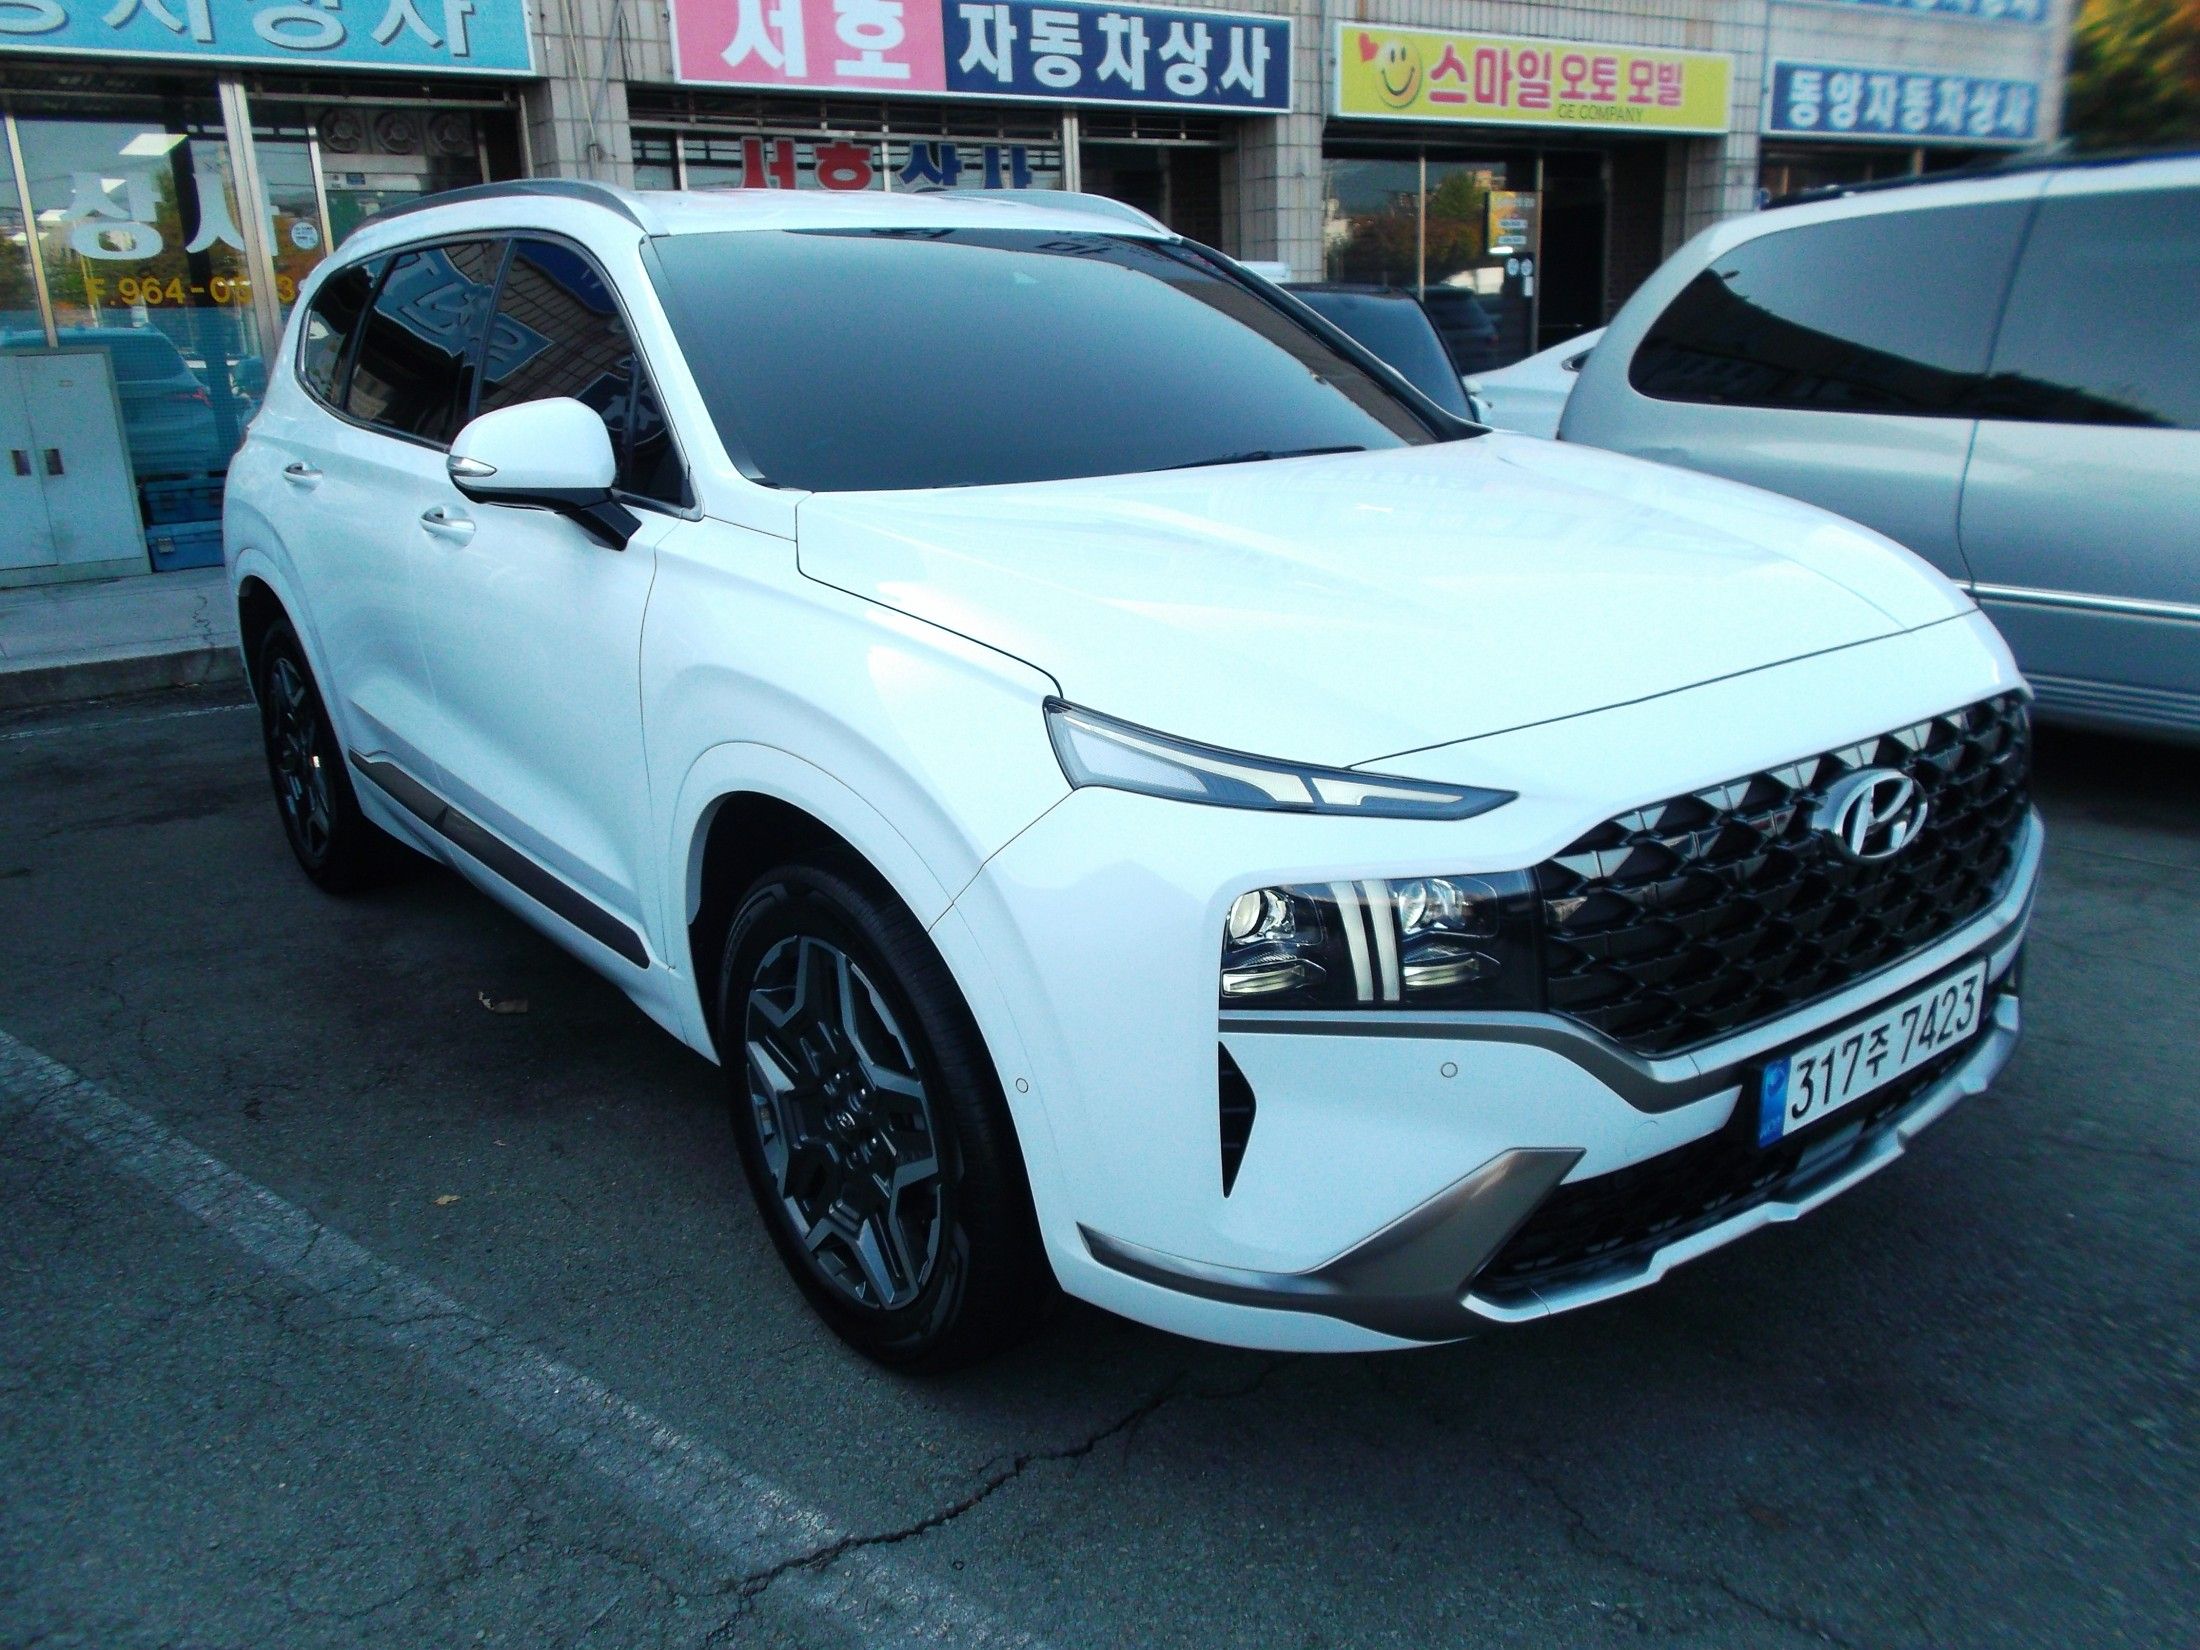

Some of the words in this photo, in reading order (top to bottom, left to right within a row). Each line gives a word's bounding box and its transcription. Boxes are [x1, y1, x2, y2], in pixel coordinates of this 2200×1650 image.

[721, 0, 912, 79] 서호
[958, 3, 1271, 98] 자동차상사
[1429, 44, 1551, 108] 스마일
[1791, 1023, 1890, 1120] 317주
[1901, 974, 1979, 1064] 7423
